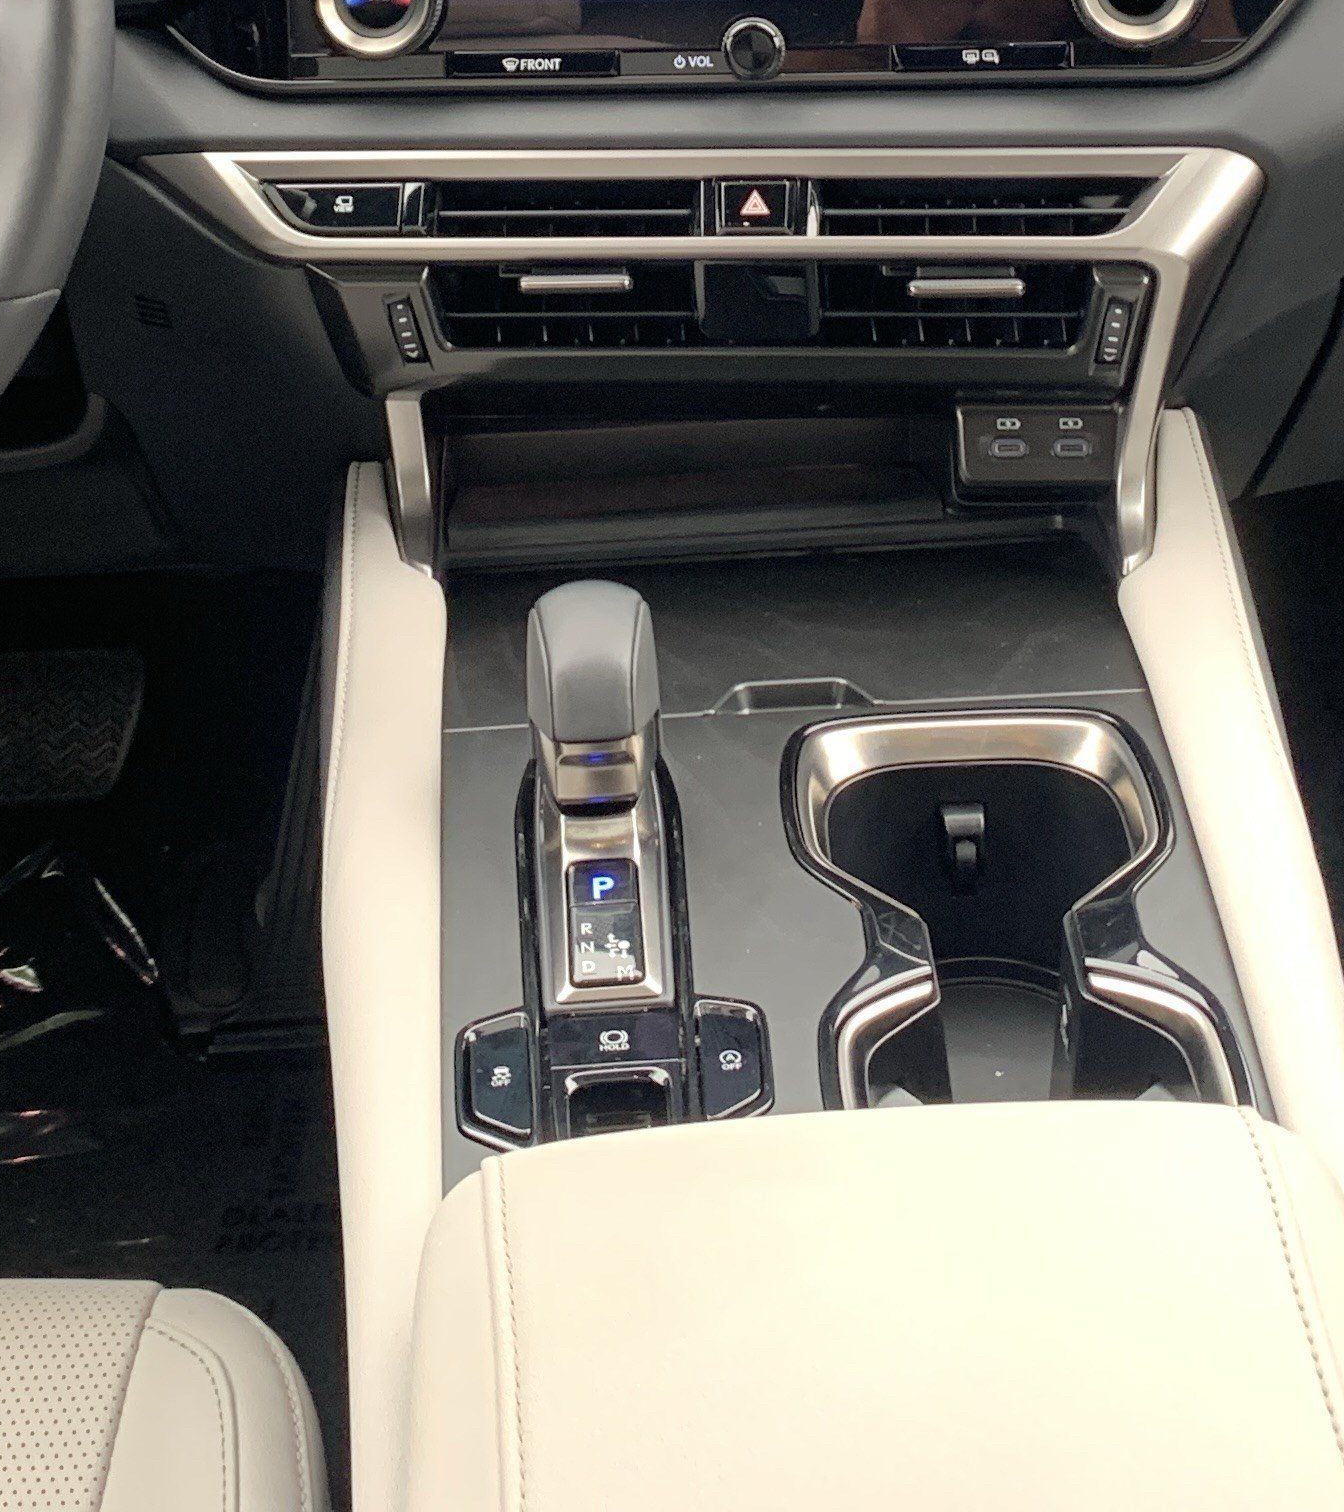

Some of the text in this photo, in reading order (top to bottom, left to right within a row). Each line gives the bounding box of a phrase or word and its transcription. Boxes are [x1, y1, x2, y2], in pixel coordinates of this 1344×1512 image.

[520, 57, 562, 72] FRONT
[688, 54, 714, 69] VOL
[591, 875, 615, 900] P
[580, 922, 592, 935] R
[579, 941, 596, 954] N
[581, 960, 596, 974] D
[599, 1041, 631, 1052] HOLD
[721, 1060, 742, 1070] OFF
[490, 1076, 511, 1087] OFF
